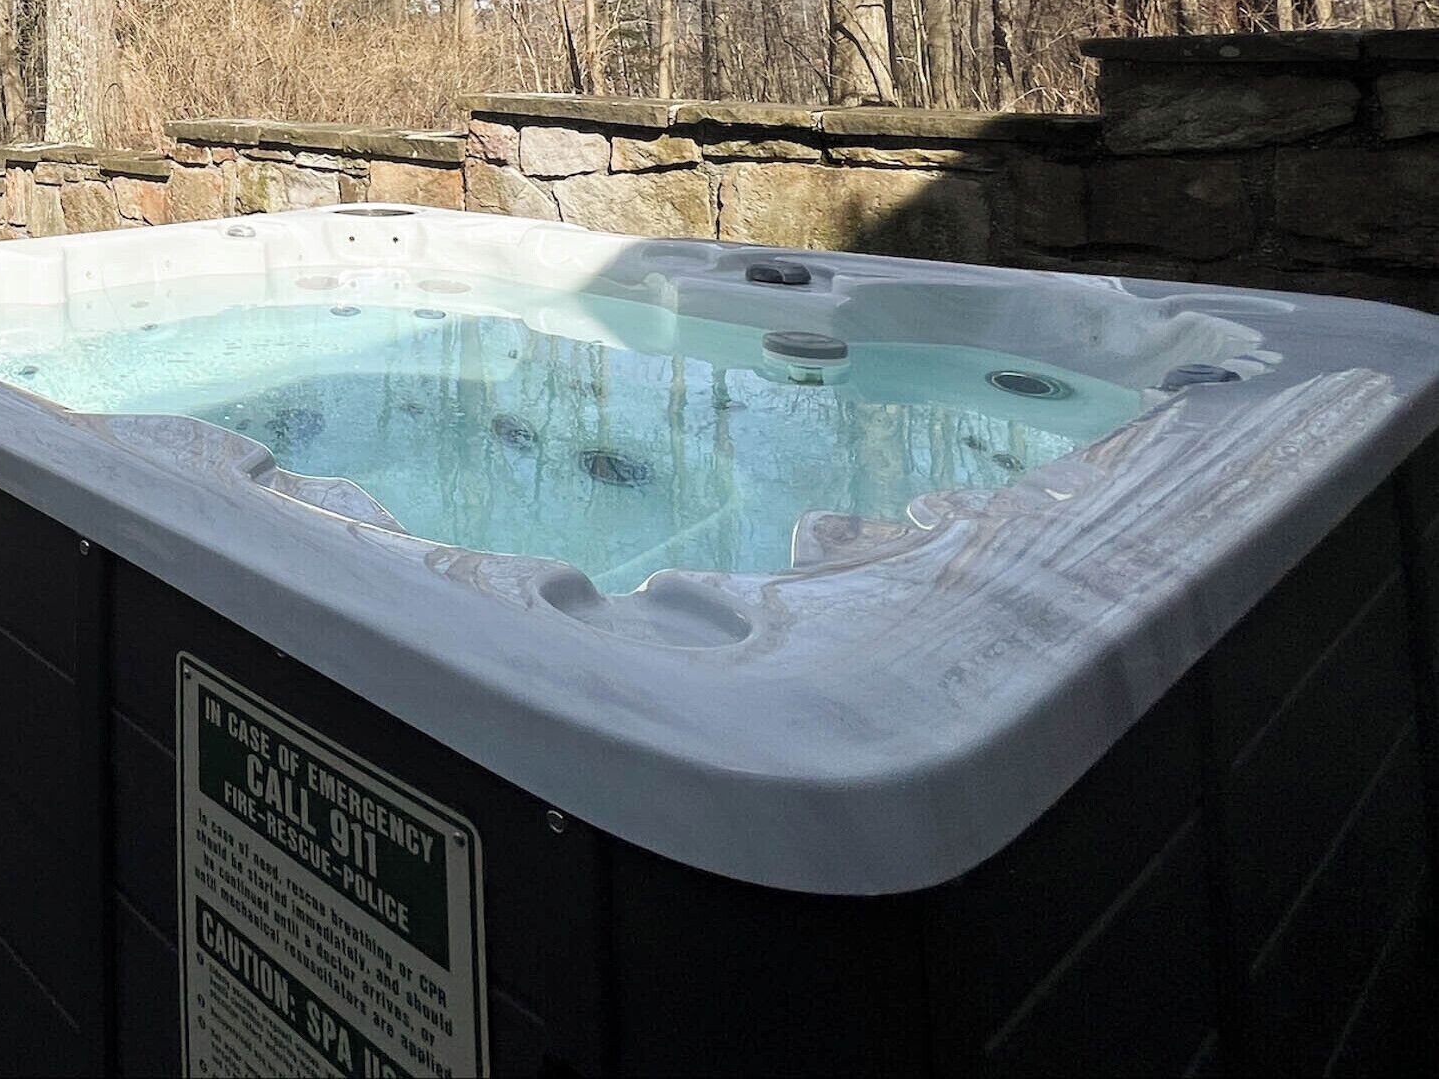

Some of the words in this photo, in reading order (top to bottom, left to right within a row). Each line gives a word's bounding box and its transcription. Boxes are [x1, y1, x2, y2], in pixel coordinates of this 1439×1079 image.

[205, 696, 221, 727] IN
[228, 712, 271, 760] CASE
[278, 744, 299, 777] OF
[308, 761, 433, 863] EMERGENCY
[247, 754, 317, 836] CALL
[330, 809, 377, 878] 911
[195, 867, 216, 892] until
[221, 887, 279, 944] mechanical
[285, 940, 366, 1015] resuscitators
[373, 1011, 393, 1038] are
[197, 830, 226, 861] should
[232, 852, 243, 873] be
[248, 869, 287, 908] started
[377, 969, 399, 995] and
[407, 992, 453, 1036] should
[203, 911, 295, 1022] CAUTION:
[307, 1000, 353, 1072] SPA
[212, 822, 234, 847] case
[239, 842, 249, 857] of
[287, 878, 325, 916] rescue
[331, 908, 392, 970] breathing
[399, 962, 413, 981] or
[420, 974, 447, 1007] CPR
[219, 867, 269, 915] continued
[274, 911, 299, 939] until
[305, 934, 311, 947] a
[317, 942, 354, 984] doctor
[421, 1028, 435, 1046] or
